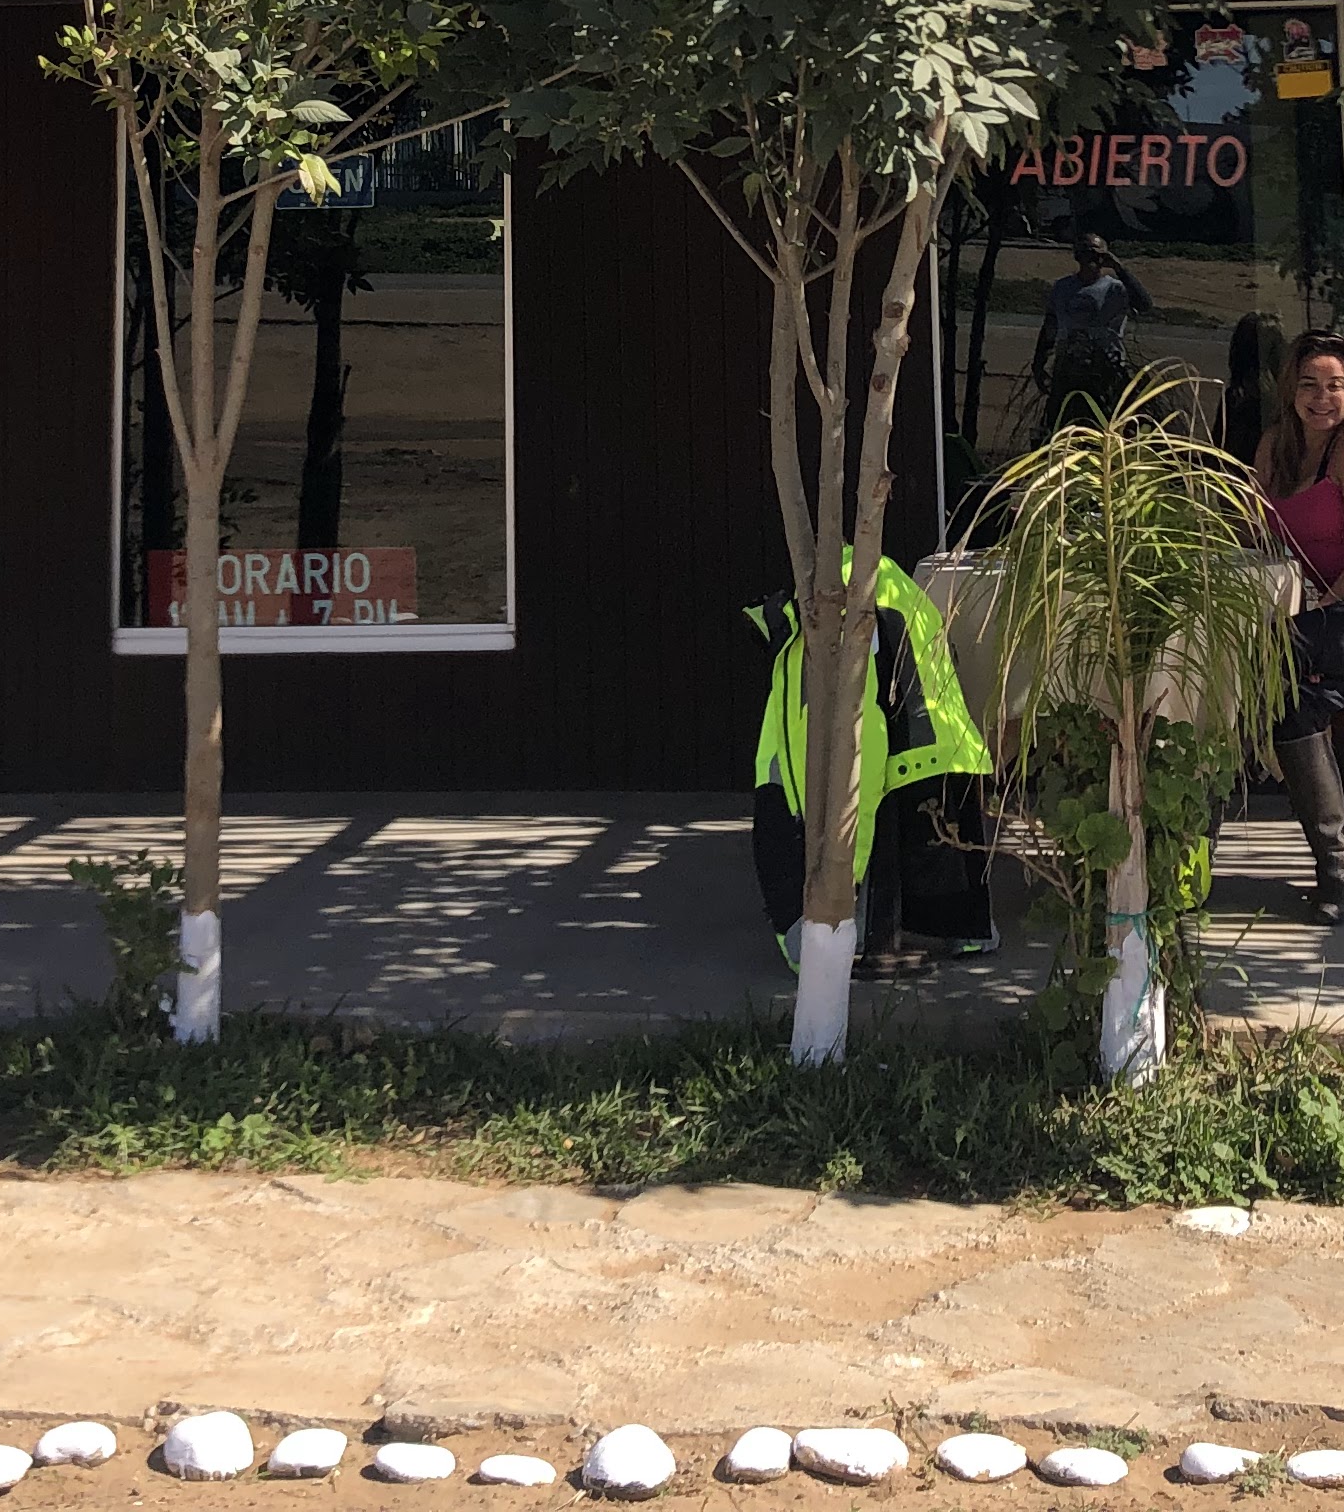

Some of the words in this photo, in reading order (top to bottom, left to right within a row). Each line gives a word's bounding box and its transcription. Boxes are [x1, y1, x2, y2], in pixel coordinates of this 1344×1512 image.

[1009, 134, 1248, 188] ABIERTO
[196, 553, 372, 595] ORARIO
[312, 599, 333, 625] 7
